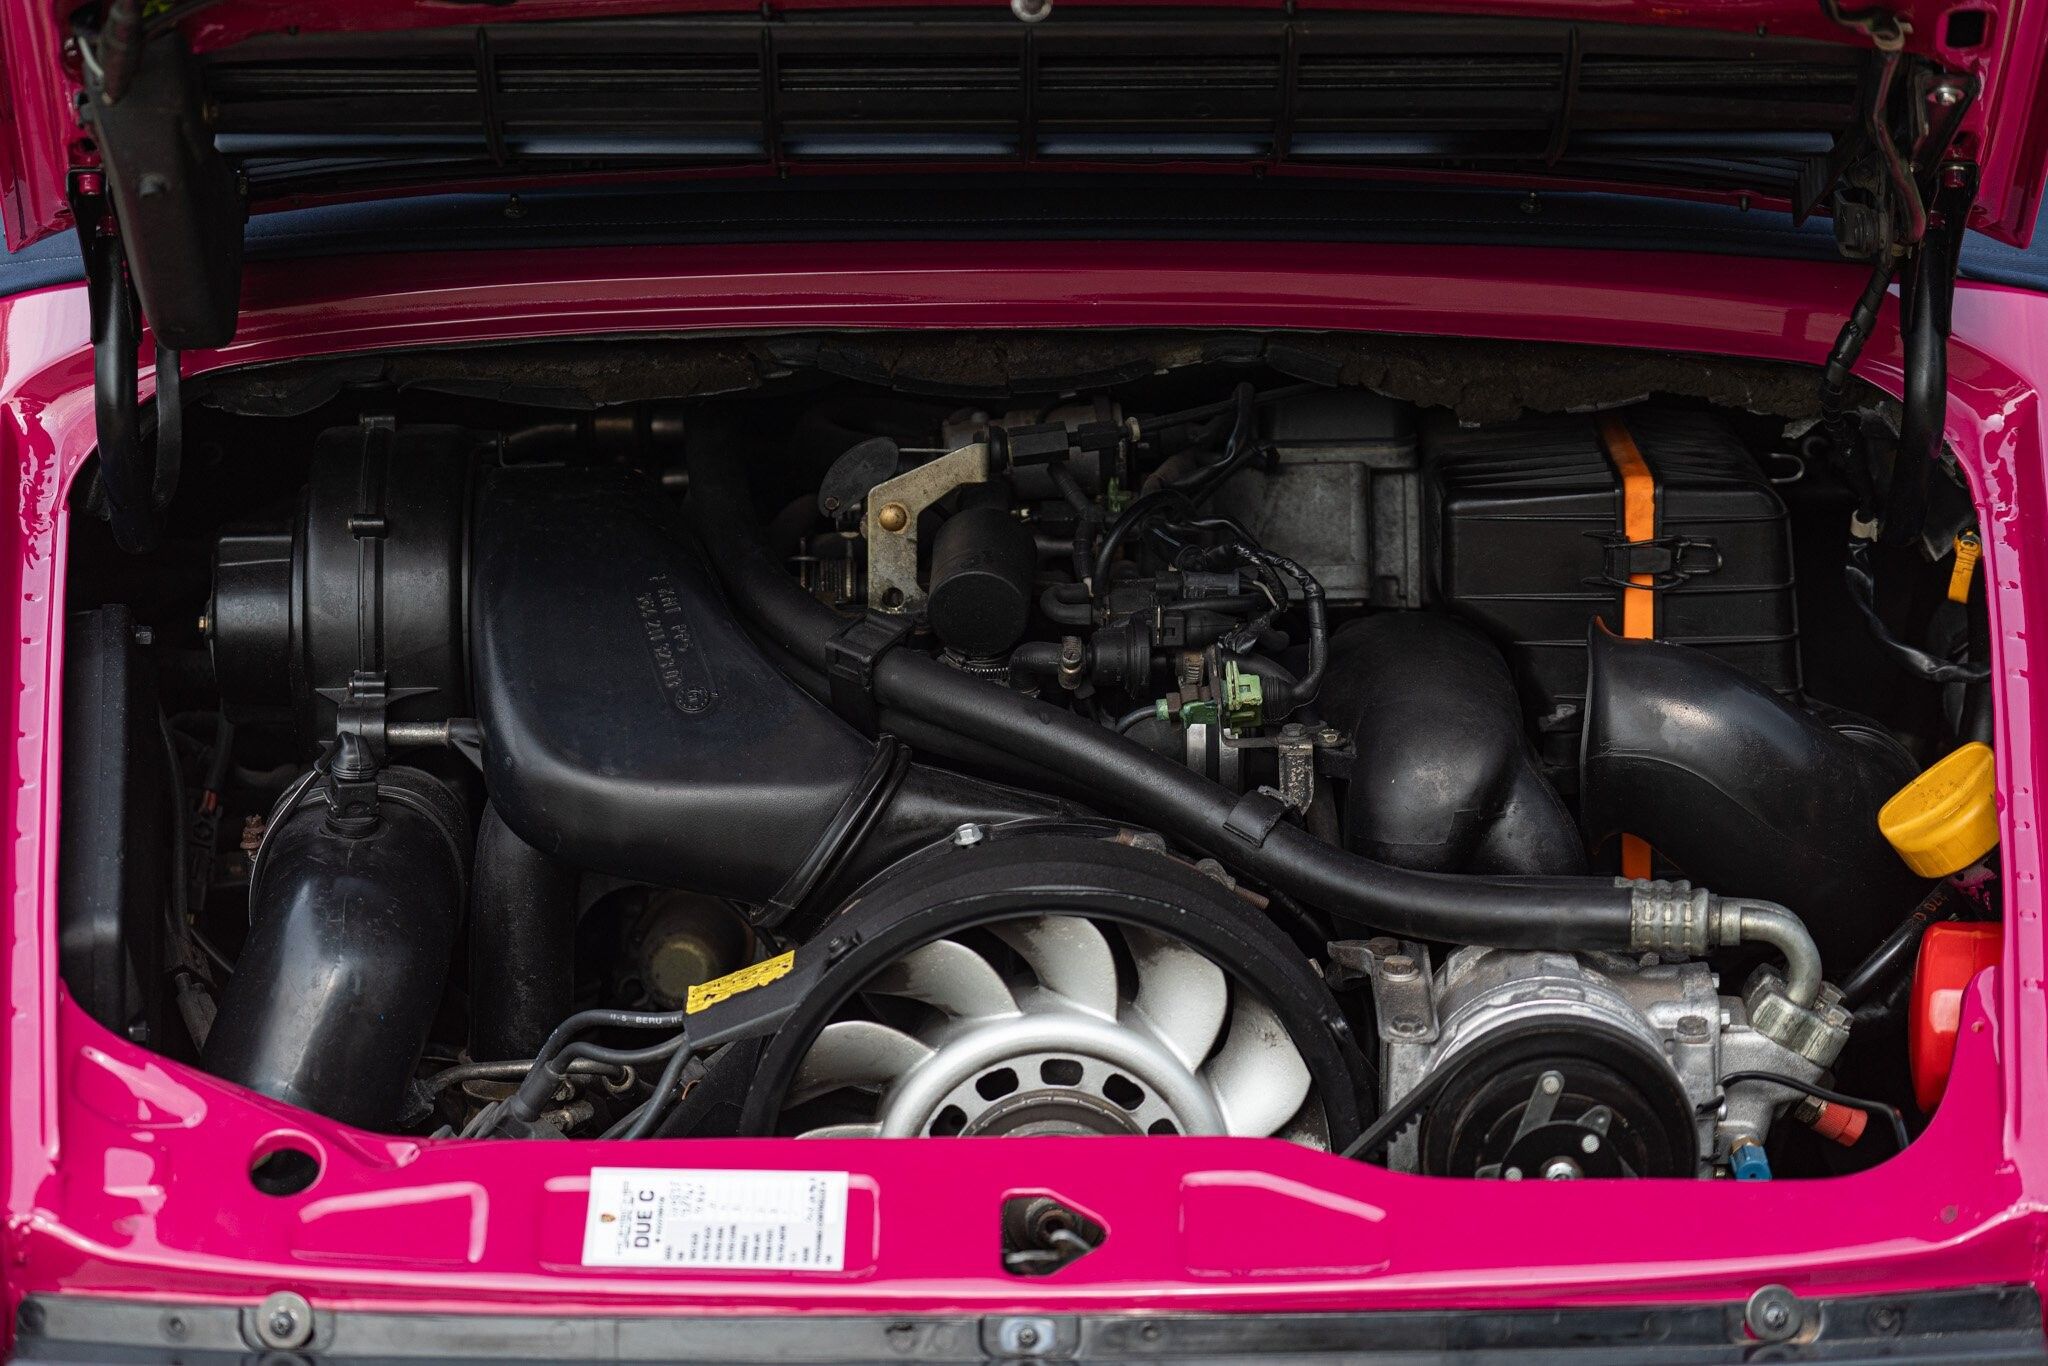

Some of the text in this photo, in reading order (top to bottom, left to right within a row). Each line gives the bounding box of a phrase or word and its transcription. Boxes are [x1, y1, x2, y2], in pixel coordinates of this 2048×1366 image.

[635, 1016, 663, 1025] BERU
[634, 1189, 655, 1249] DUE C
